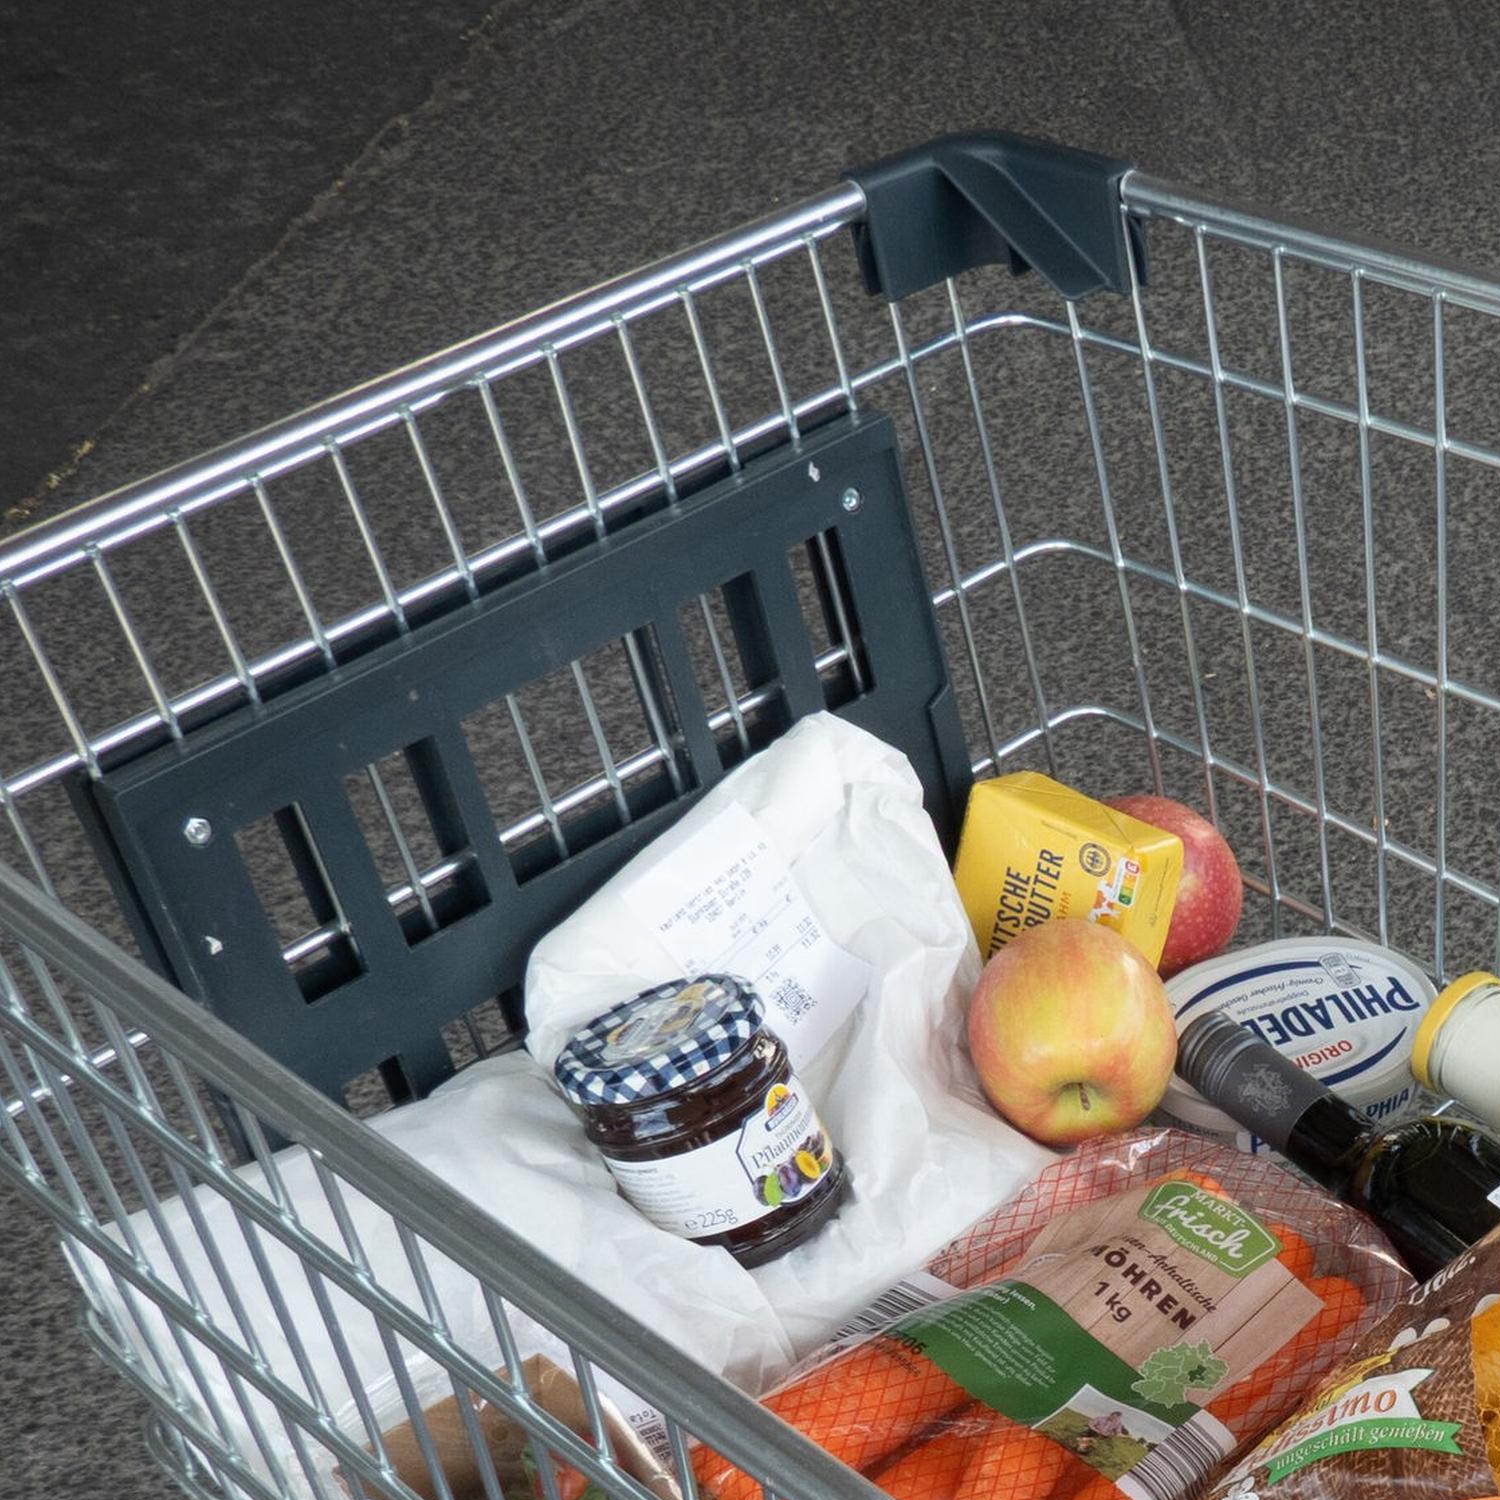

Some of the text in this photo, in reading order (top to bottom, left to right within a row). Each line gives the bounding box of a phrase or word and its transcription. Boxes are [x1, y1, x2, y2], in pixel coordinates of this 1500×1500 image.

[987, 865, 1031, 960] UTSCHE
[1021, 848, 1065, 933] BUTTER
[1151, 1194, 1246, 1260] frisch
[1093, 1280, 1134, 1324] 1 kg
[1275, 1422, 1446, 1468] ungeschält genießen
